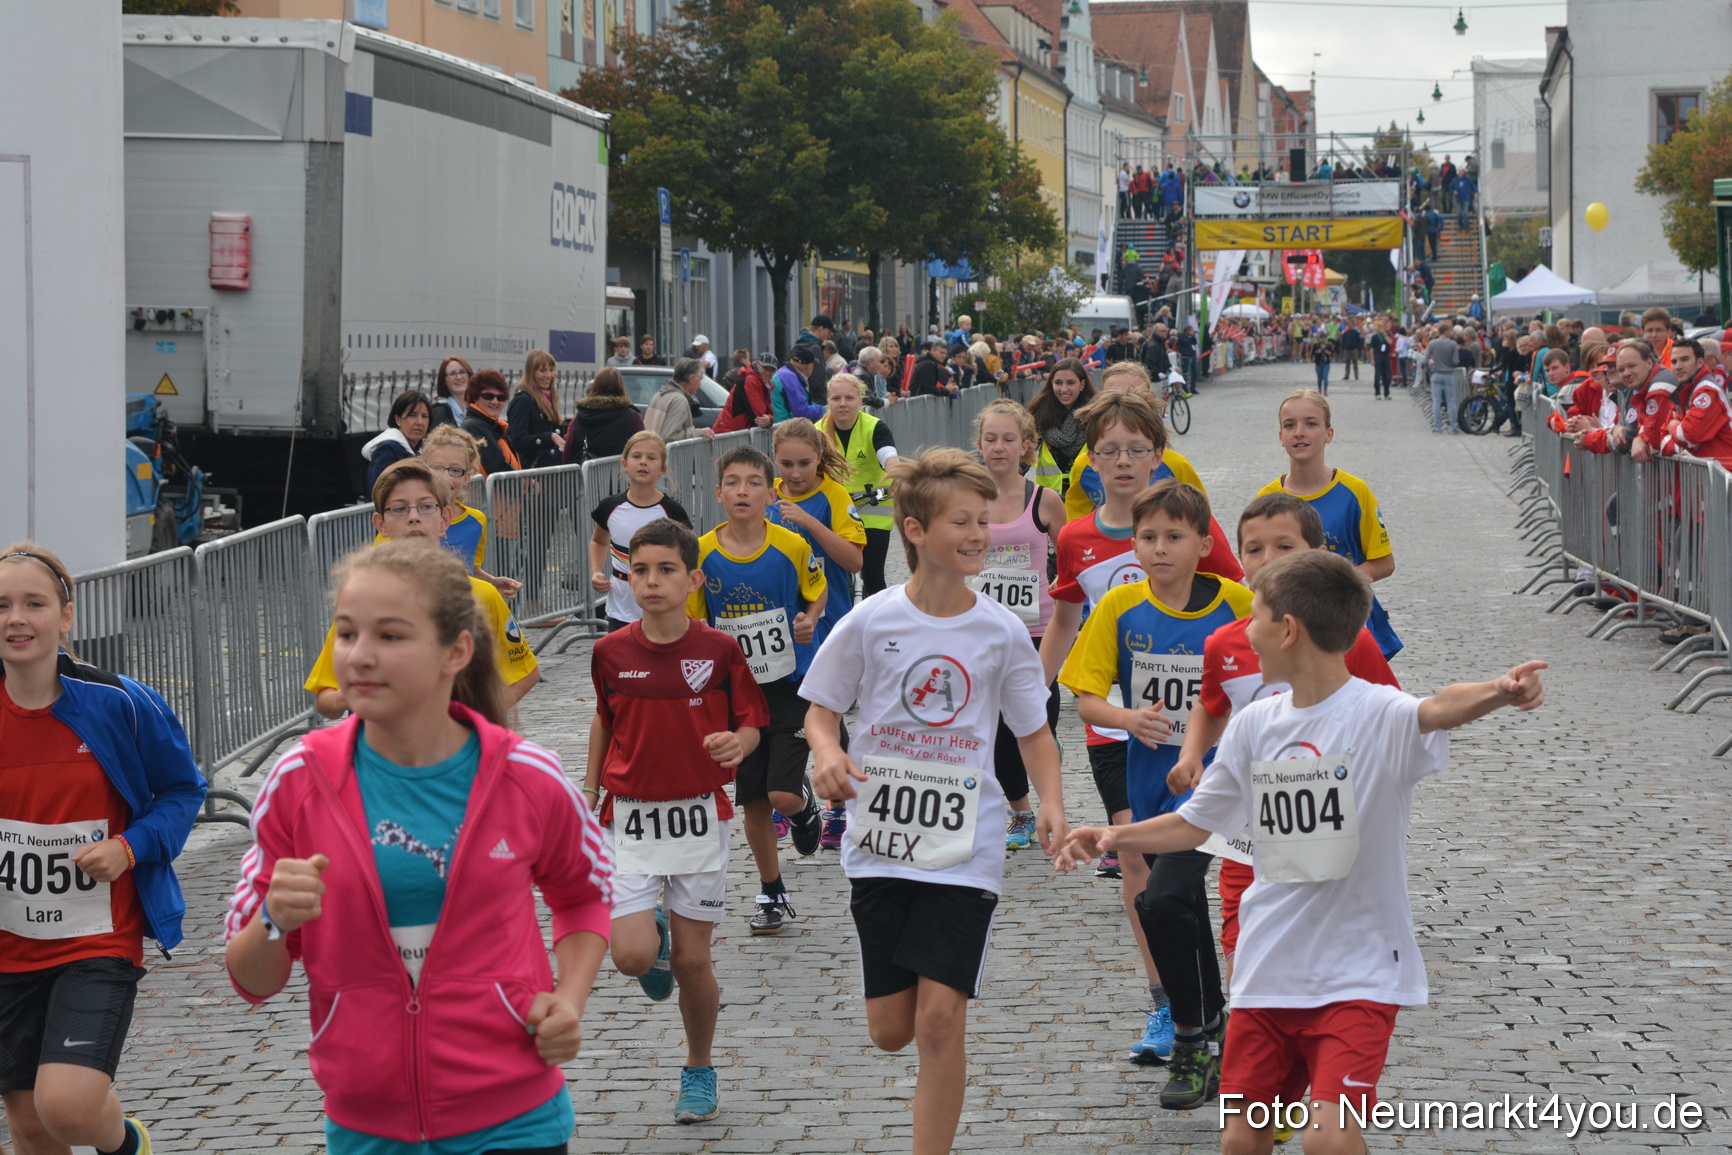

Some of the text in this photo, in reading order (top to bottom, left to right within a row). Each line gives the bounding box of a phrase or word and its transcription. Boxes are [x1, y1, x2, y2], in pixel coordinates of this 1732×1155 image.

[551, 182, 597, 253] BOCK
[1263, 225, 1334, 242] START
[716, 618, 773, 632] PARTL Neumarkt
[735, 627, 785, 659] 013
[618, 670, 650, 678] saller
[1135, 660, 1204, 674] PARTL Neuma
[689, 698, 703, 706] MD
[1142, 677, 1203, 711] 405
[1169, 721, 1186, 733] Ma
[880, 740, 892, 750] Dr.
[894, 744, 914, 756] Heck
[923, 751, 934, 760] Dr.
[937, 752, 965, 764] Röschl
[864, 766, 959, 787] PARTL Neumarkt
[1275, 770, 1329, 784] Neumarkt
[868, 784, 966, 831] 4003
[1260, 787, 1345, 835] 4004
[624, 804, 708, 840] 4100
[0, 831, 87, 847] ARTL Neumarkt
[858, 828, 921, 862] ALEX
[26, 906, 63, 922] Lara
